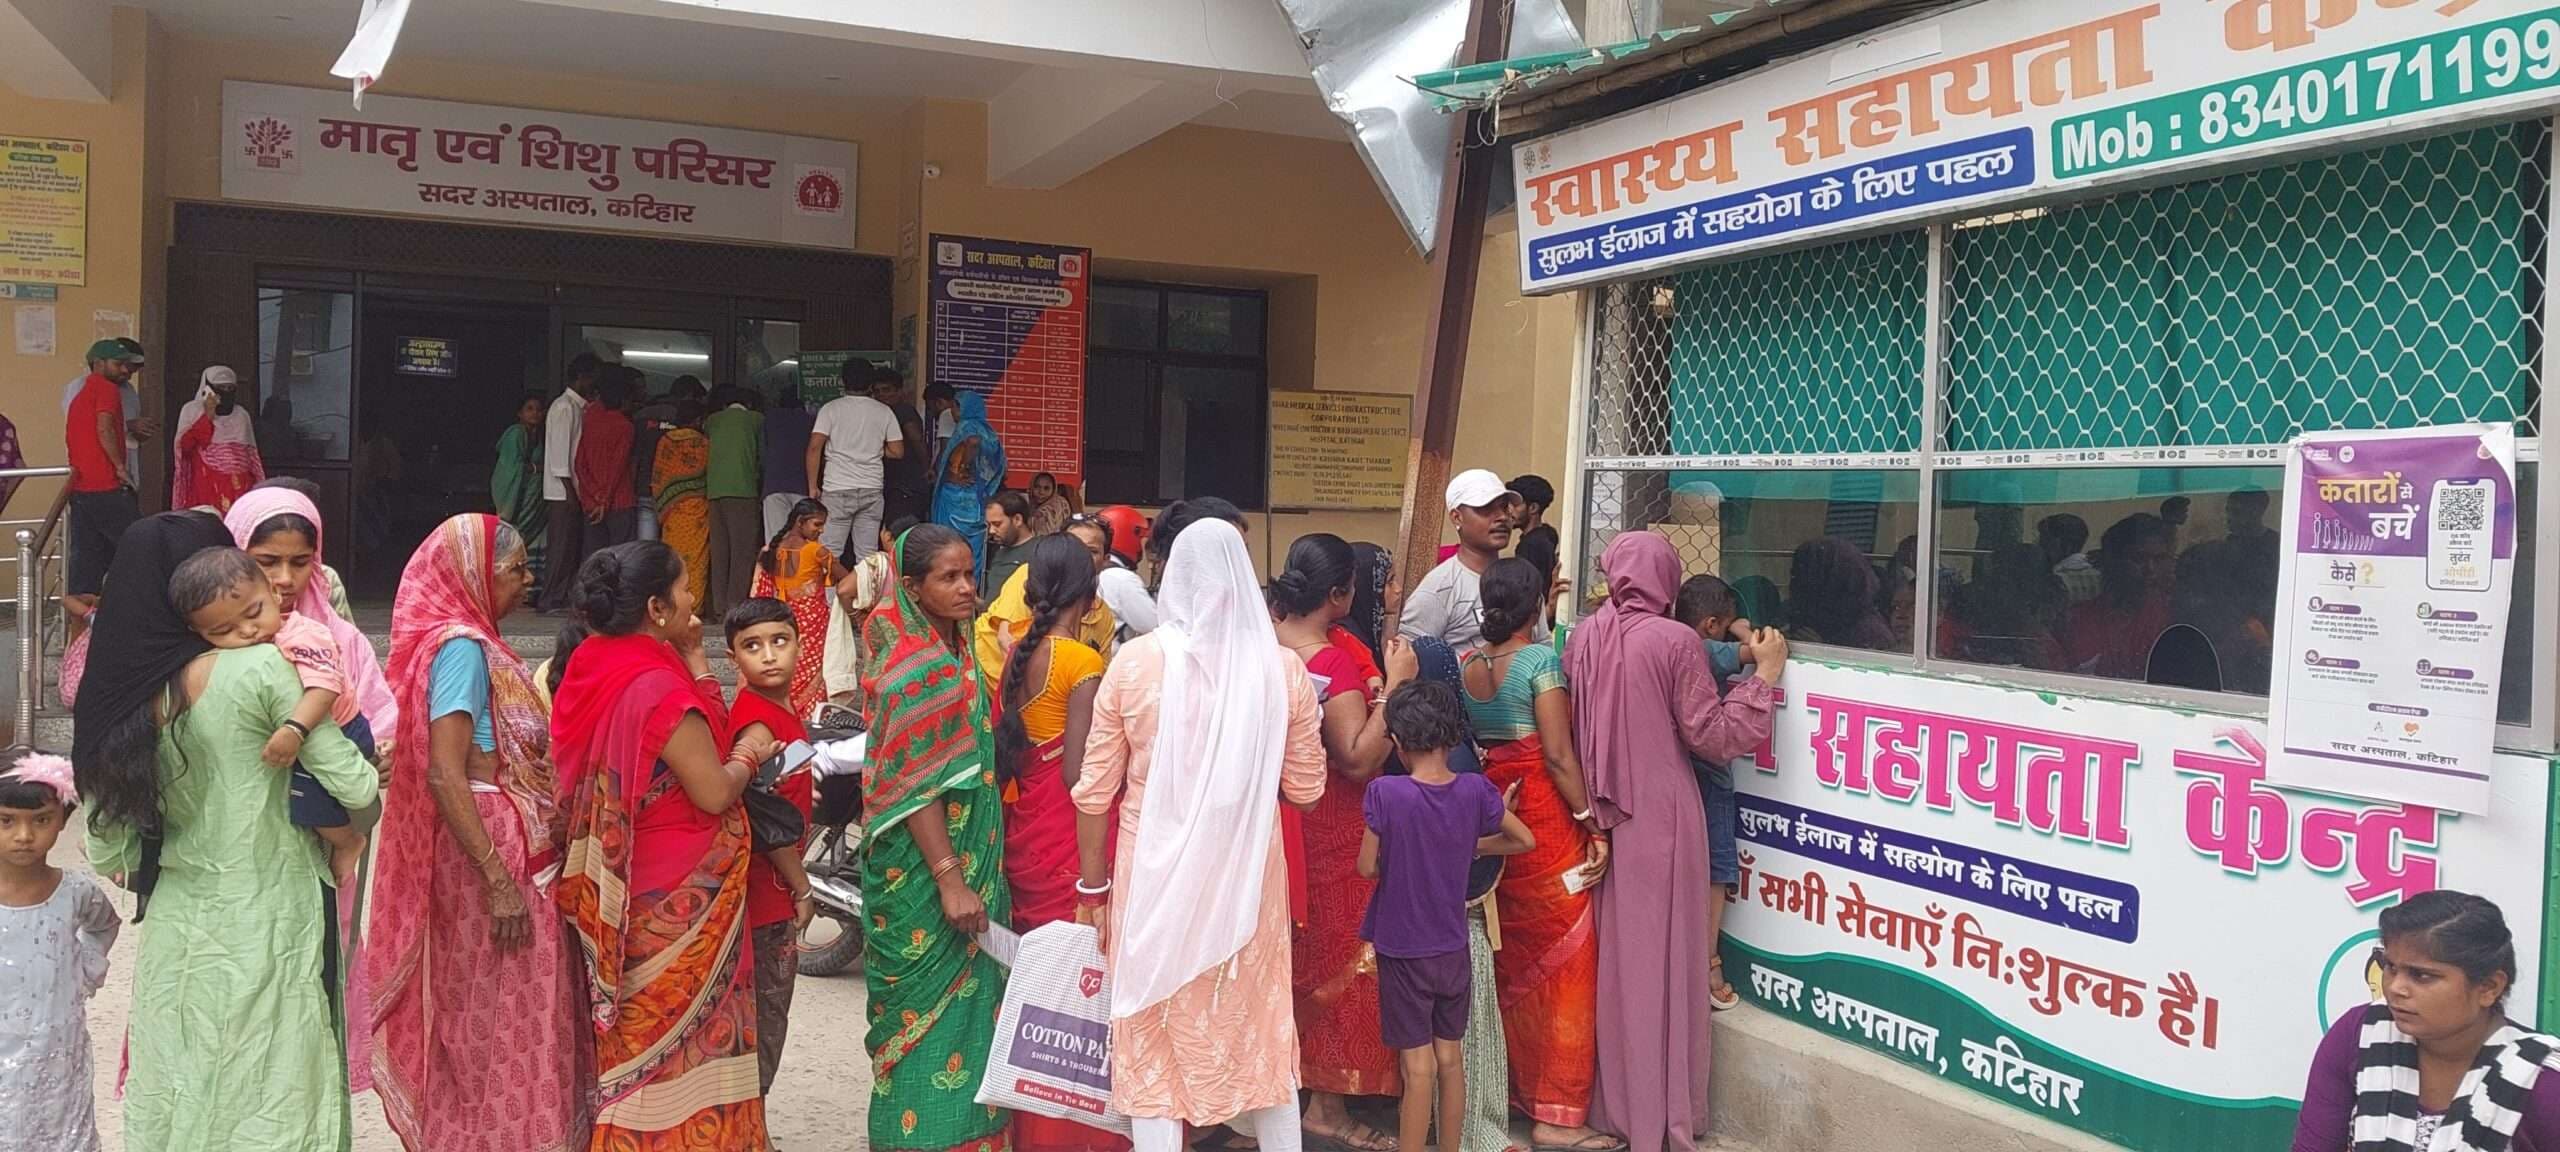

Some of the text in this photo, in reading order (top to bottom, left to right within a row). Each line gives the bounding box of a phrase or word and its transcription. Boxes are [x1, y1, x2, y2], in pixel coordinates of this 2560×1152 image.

[1525, 2, 2161, 227] स्वास्थ्य सहायता
[2061, 111, 2154, 172] Mob
[2199, 18, 2560, 144] 8340171199
[318, 118, 776, 192] मातृ एवं शिशु परिसर
[417, 182, 696, 223] सदर अस्पताल, कटिहार
[1536, 145, 2017, 276] सुलभ ईलाज में सहयोग के लिए पहल
[2317, 471, 2414, 503] कतारों से
[2368, 504, 2420, 540] बचें
[2330, 559, 2374, 584] कैसे ?
[1807, 692, 2140, 848] सहायता
[1740, 806, 2122, 923] सुलभ ईलाज में सहयोग के लिए पहल
[1758, 871, 1829, 926] सभी
[1835, 881, 1945, 968] सेवाएँ
[1021, 1022, 1086, 1054] COTTON
[1031, 1051, 1060, 1065] SHIRTS
[1751, 963, 2083, 1117] सदर अस्पताल, कटिहार
